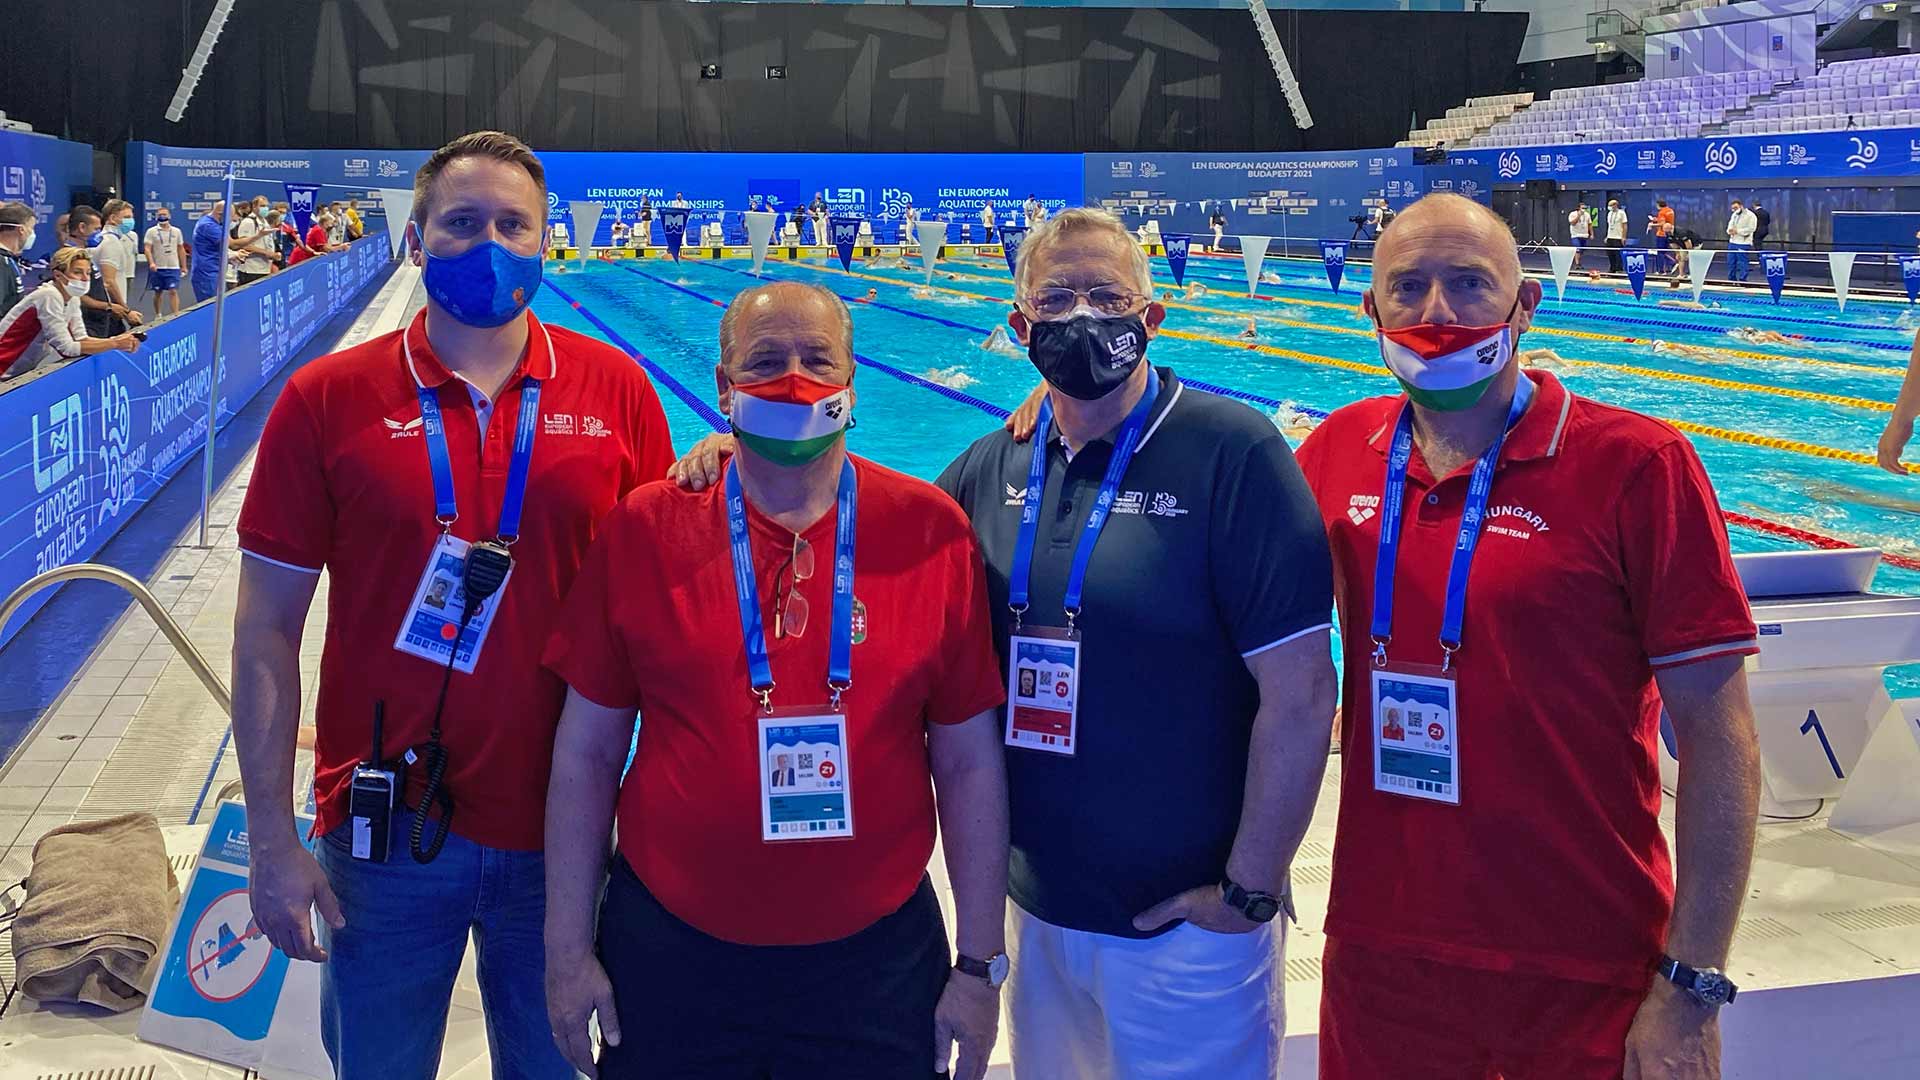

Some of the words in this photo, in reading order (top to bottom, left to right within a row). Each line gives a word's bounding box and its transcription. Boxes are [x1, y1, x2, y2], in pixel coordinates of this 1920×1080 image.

[1760, 145, 1781, 155] LEN
[232, 160, 310, 168] CHAMPIONSHIPS
[1256, 161, 1298, 169] AQUATICS
[1299, 160, 1359, 169] CHAMPIONSHIPS
[187, 169, 224, 177] BUDAPEST
[587, 188, 606, 197] LEN
[608, 188, 663, 197] EUROPEAN
[824, 188, 865, 203] LEN
[938, 188, 956, 197] LEN
[957, 188, 1009, 197] EUROPEAN
[938, 199, 986, 209] AQUATICS
[1107, 331, 1137, 355] LEN
[1476, 341, 1499, 358] arena
[149, 349, 163, 388] LEN
[163, 332, 197, 379] EUROPEAN
[151, 382, 184, 436] AQUATICS
[544, 414, 573, 424] LEN
[32, 393, 84, 493] LEN
[35, 475, 86, 539] european
[1350, 494, 1380, 507] arena
[1486, 524, 1508, 535] SWIM
[1508, 528, 1530, 540] TEAM
[36, 514, 87, 577] aquatics
[1800, 709, 1845, 779] 1
[227, 829, 249, 846] LE
